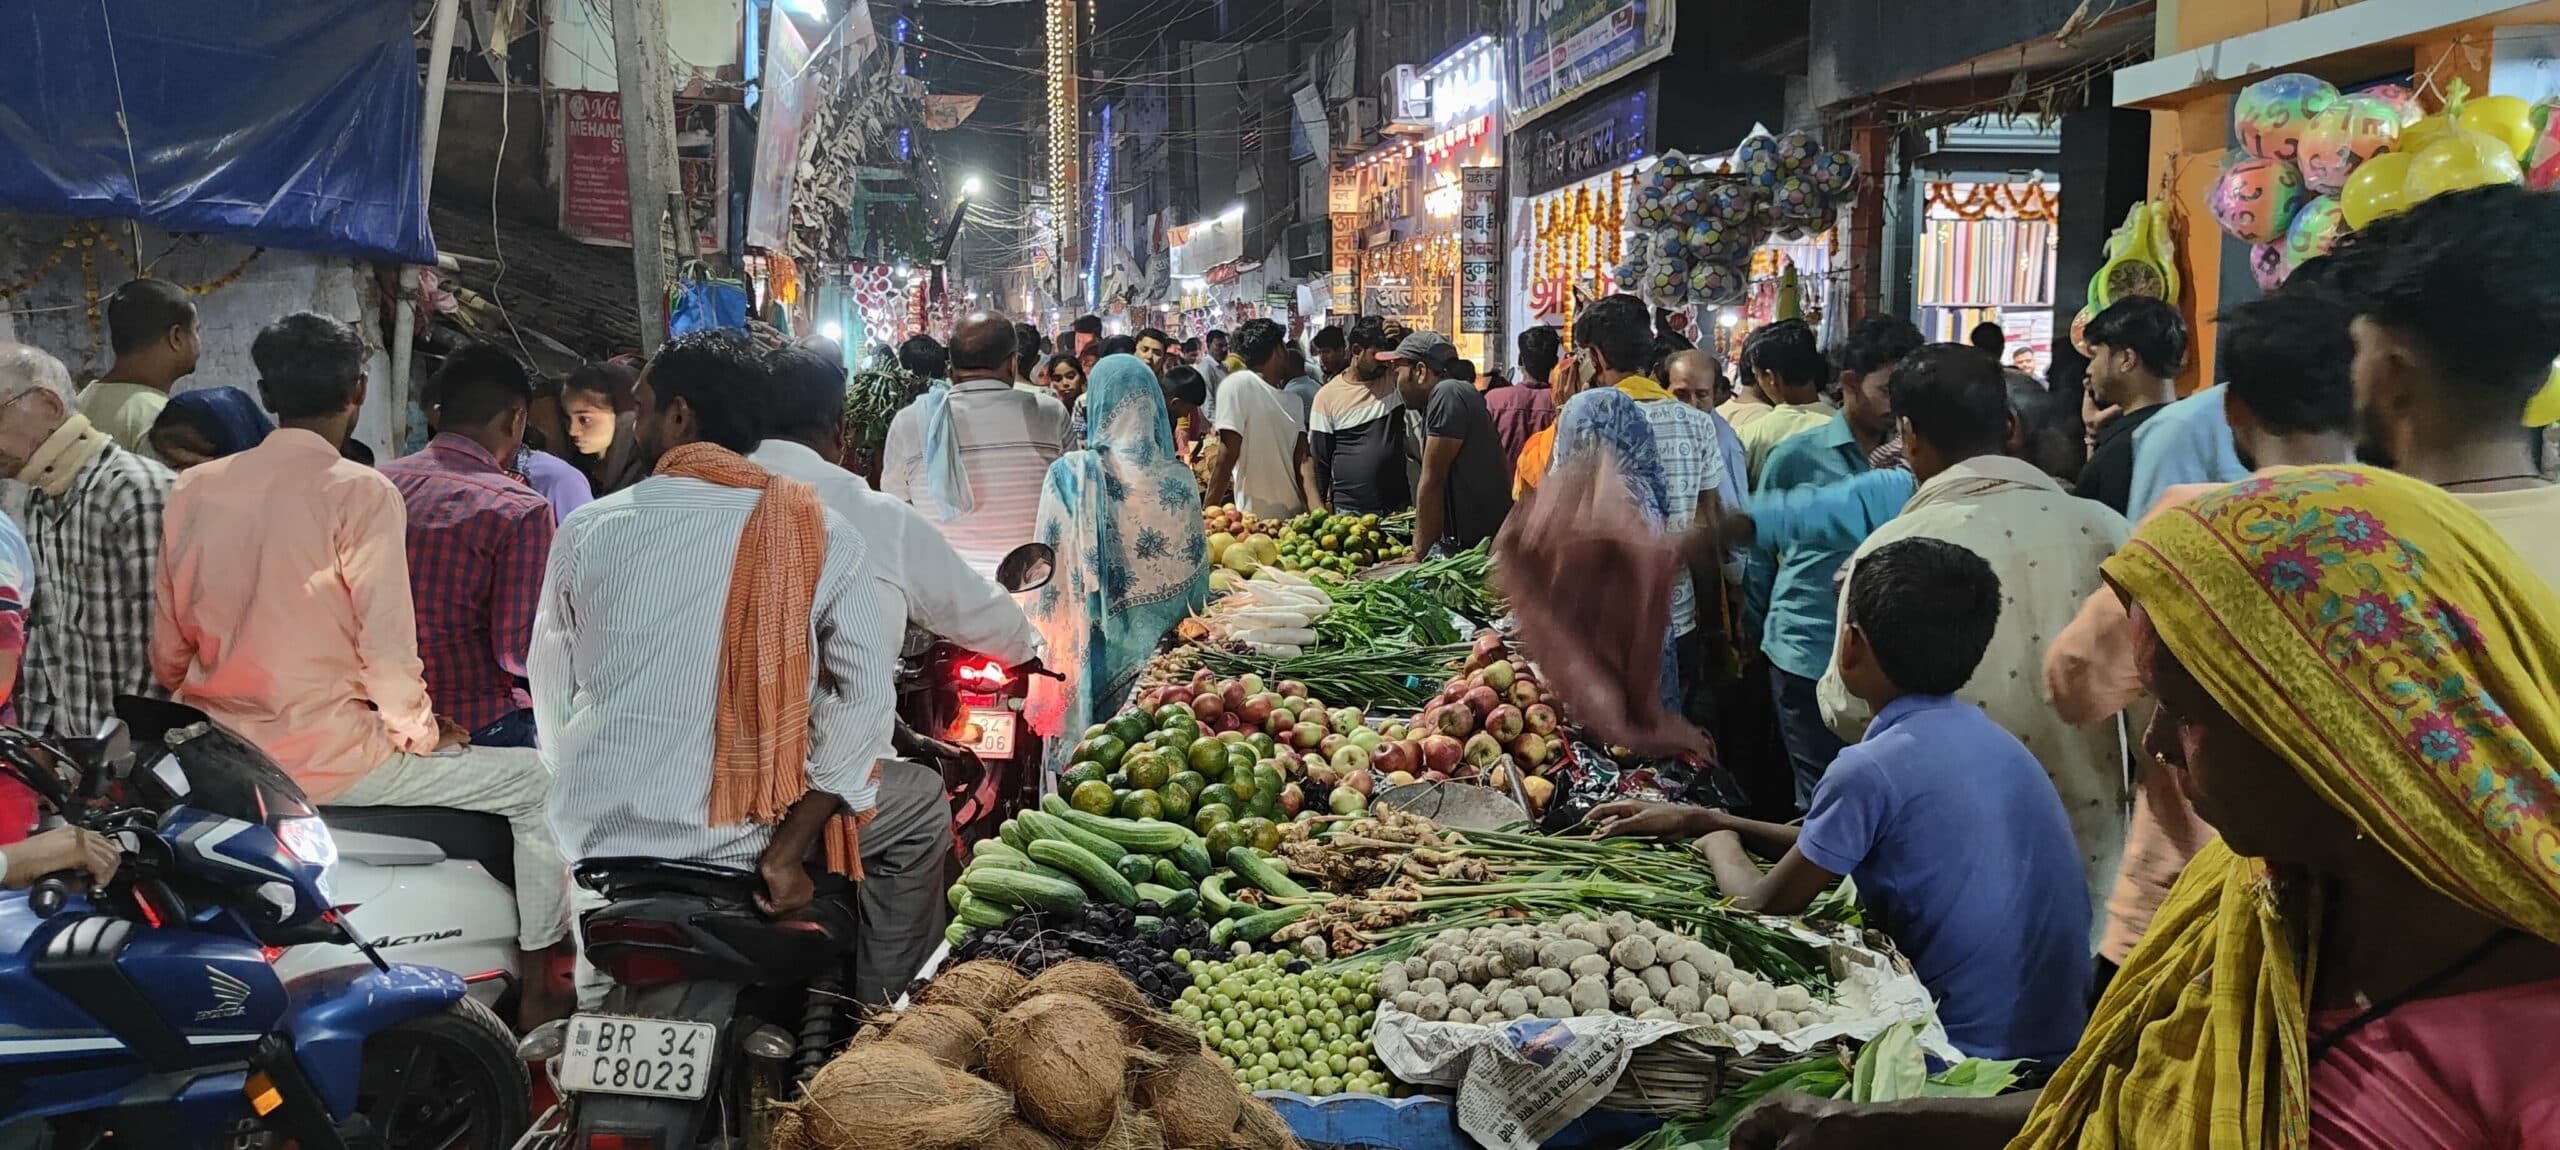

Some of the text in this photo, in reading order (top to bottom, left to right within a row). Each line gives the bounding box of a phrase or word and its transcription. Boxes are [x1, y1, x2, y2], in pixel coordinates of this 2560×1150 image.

[1464, 216, 1488, 236] बाबू
[1463, 262, 1497, 282] दुकान
[1463, 279, 1497, 299] ज्योति
[1463, 300, 1500, 317] ज्वेलर्स
[980, 718, 999, 732] 34
[974, 735, 1005, 750] 06
[366, 928, 462, 949] ACTIVA
[597, 1022, 697, 1057] BR 34
[1583, 1050, 1604, 1070] साथ
[593, 1056, 694, 1092] C8023
[1497, 1122, 1518, 1143] मोदी
